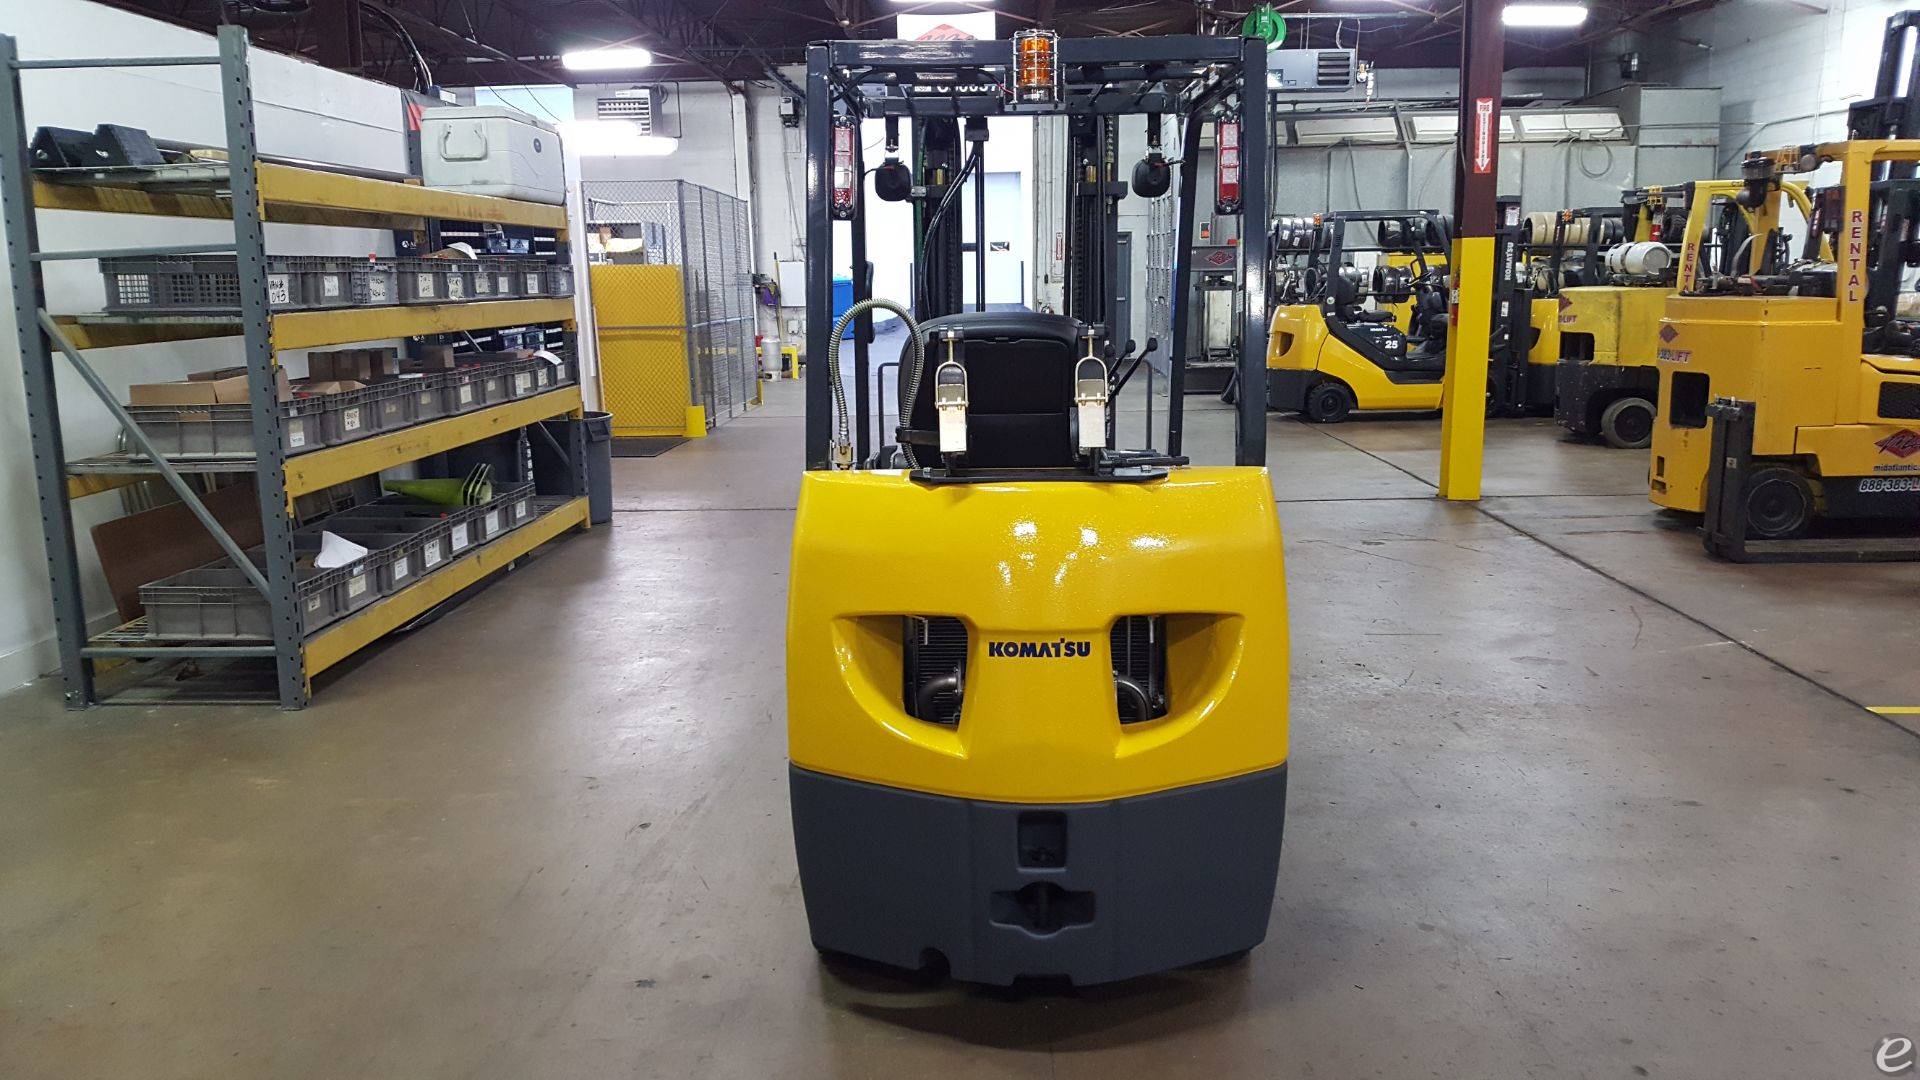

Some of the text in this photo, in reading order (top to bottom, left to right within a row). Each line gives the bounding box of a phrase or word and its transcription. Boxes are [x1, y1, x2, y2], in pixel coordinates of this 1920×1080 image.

[1504, 242, 1514, 280] KOMATSU
[1848, 211, 1862, 301] RENTAL
[1385, 340, 1398, 349] 25
[989, 638, 1091, 657] KOMATSU
